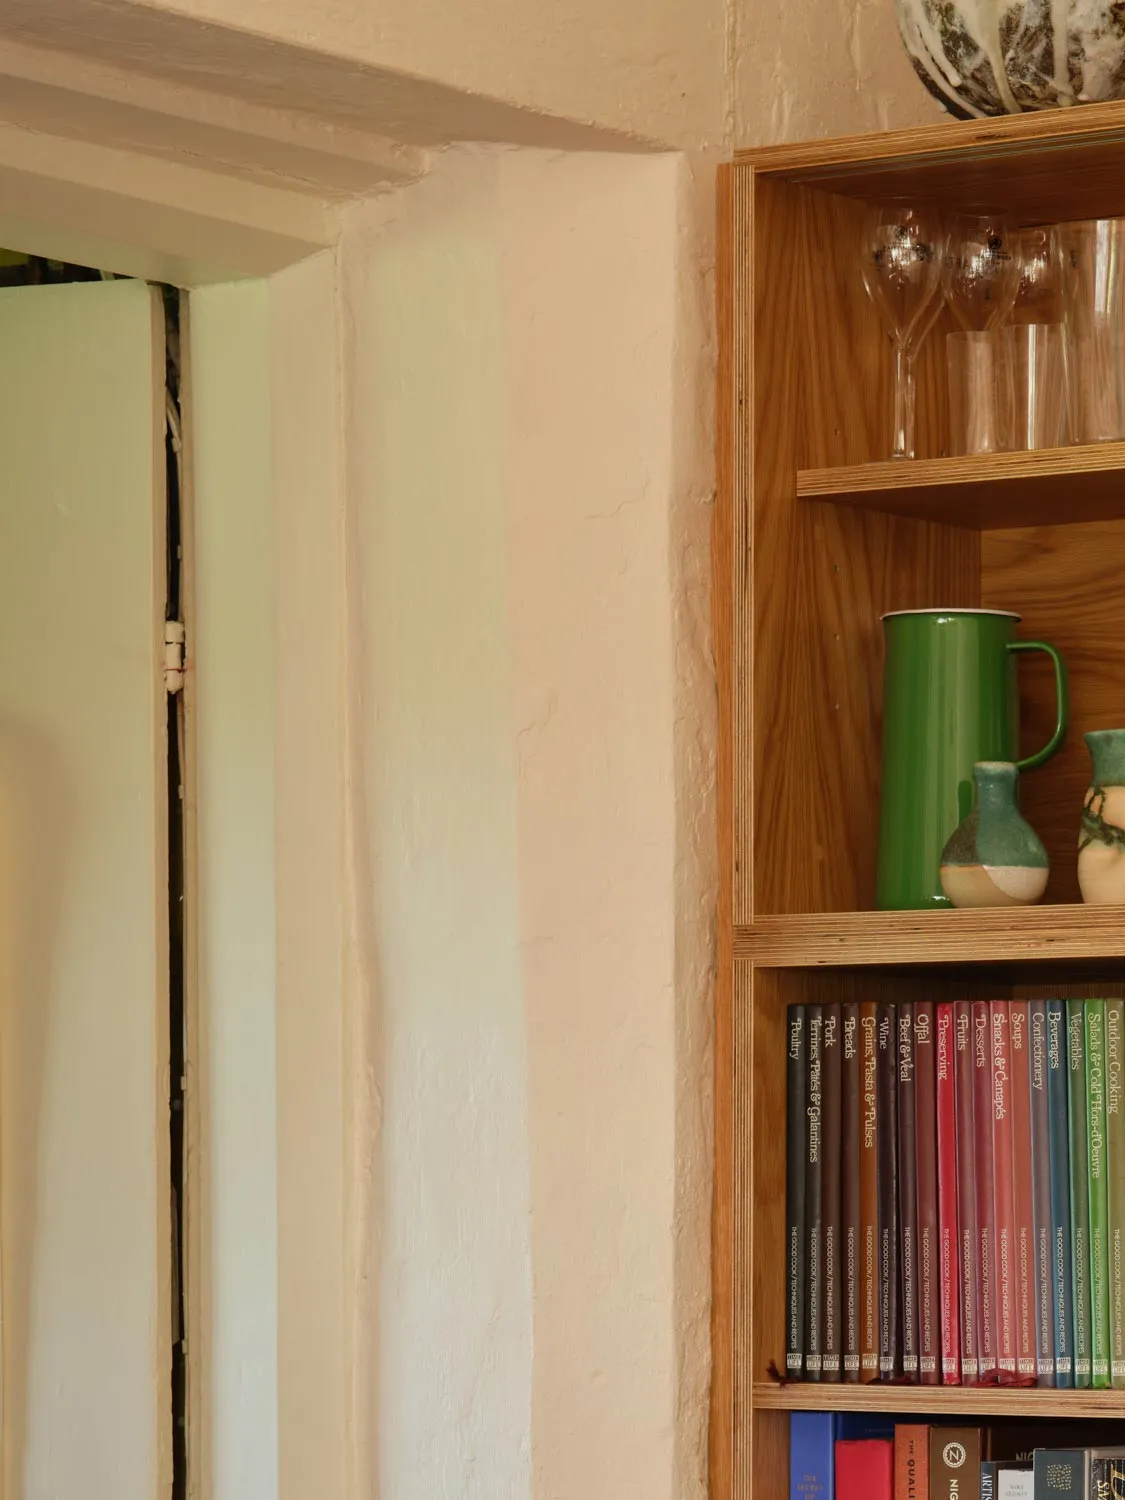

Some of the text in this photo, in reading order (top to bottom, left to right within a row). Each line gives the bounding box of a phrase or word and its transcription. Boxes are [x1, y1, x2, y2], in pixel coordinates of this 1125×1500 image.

[789, 1018, 802, 1060] Poultry
[825, 1015, 836, 1048] Pork
[844, 1016, 856, 1059] Breads
[880, 1016, 889, 1050] Wine
[900, 1014, 914, 1082] Beef & Veal
[914, 1013, 930, 1044] Offal
[938, 1014, 953, 1080] Preserving
[957, 1013, 969, 1051] Fruits
[976, 1013, 987, 1067] Desserts
[1012, 1012, 1024, 1050] Soups
[1047, 1010, 1061, 1069] Beverages
[1068, 1012, 1082, 1070] Vegetables
[1088, 1012, 1101, 1051] Salads
[993, 1013, 1008, 1120] Snacks & Canapés
[1032, 1012, 1045, 1090] Confectionery
[1091, 1053, 1102, 1067] &
[1108, 1009, 1122, 1114] Outdoor Cooking
[811, 1092, 821, 1105] &
[862, 1016, 877, 1148] Grains, Pasta & Pulses
[1090, 1067, 1102, 1094] Cold
[807, 1106, 821, 1163] Galantines
